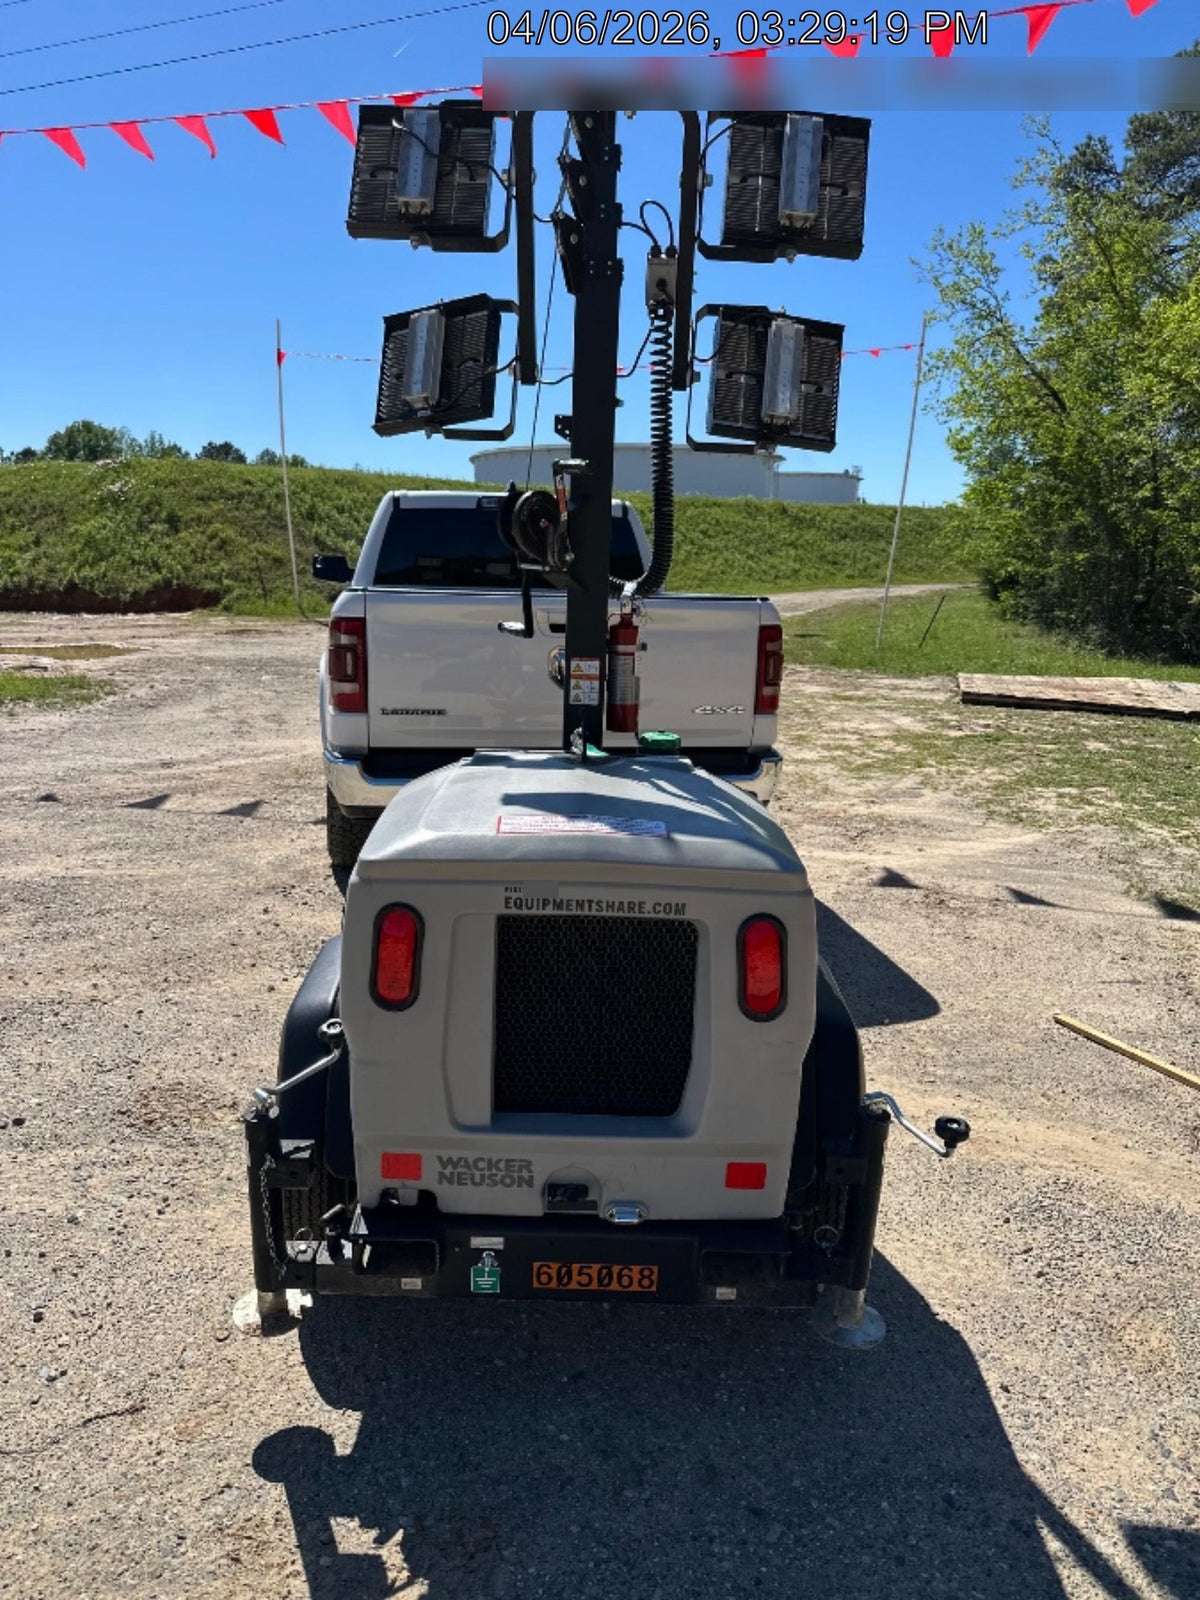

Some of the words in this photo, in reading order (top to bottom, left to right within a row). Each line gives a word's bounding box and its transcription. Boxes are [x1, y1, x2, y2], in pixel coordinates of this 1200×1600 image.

[504, 896, 687, 916] EQUIPMENTSHARE.COM
[436, 1155, 534, 1174] WACKER
[437, 1170, 534, 1188] NEUSON
[535, 1263, 655, 1289] 605068
